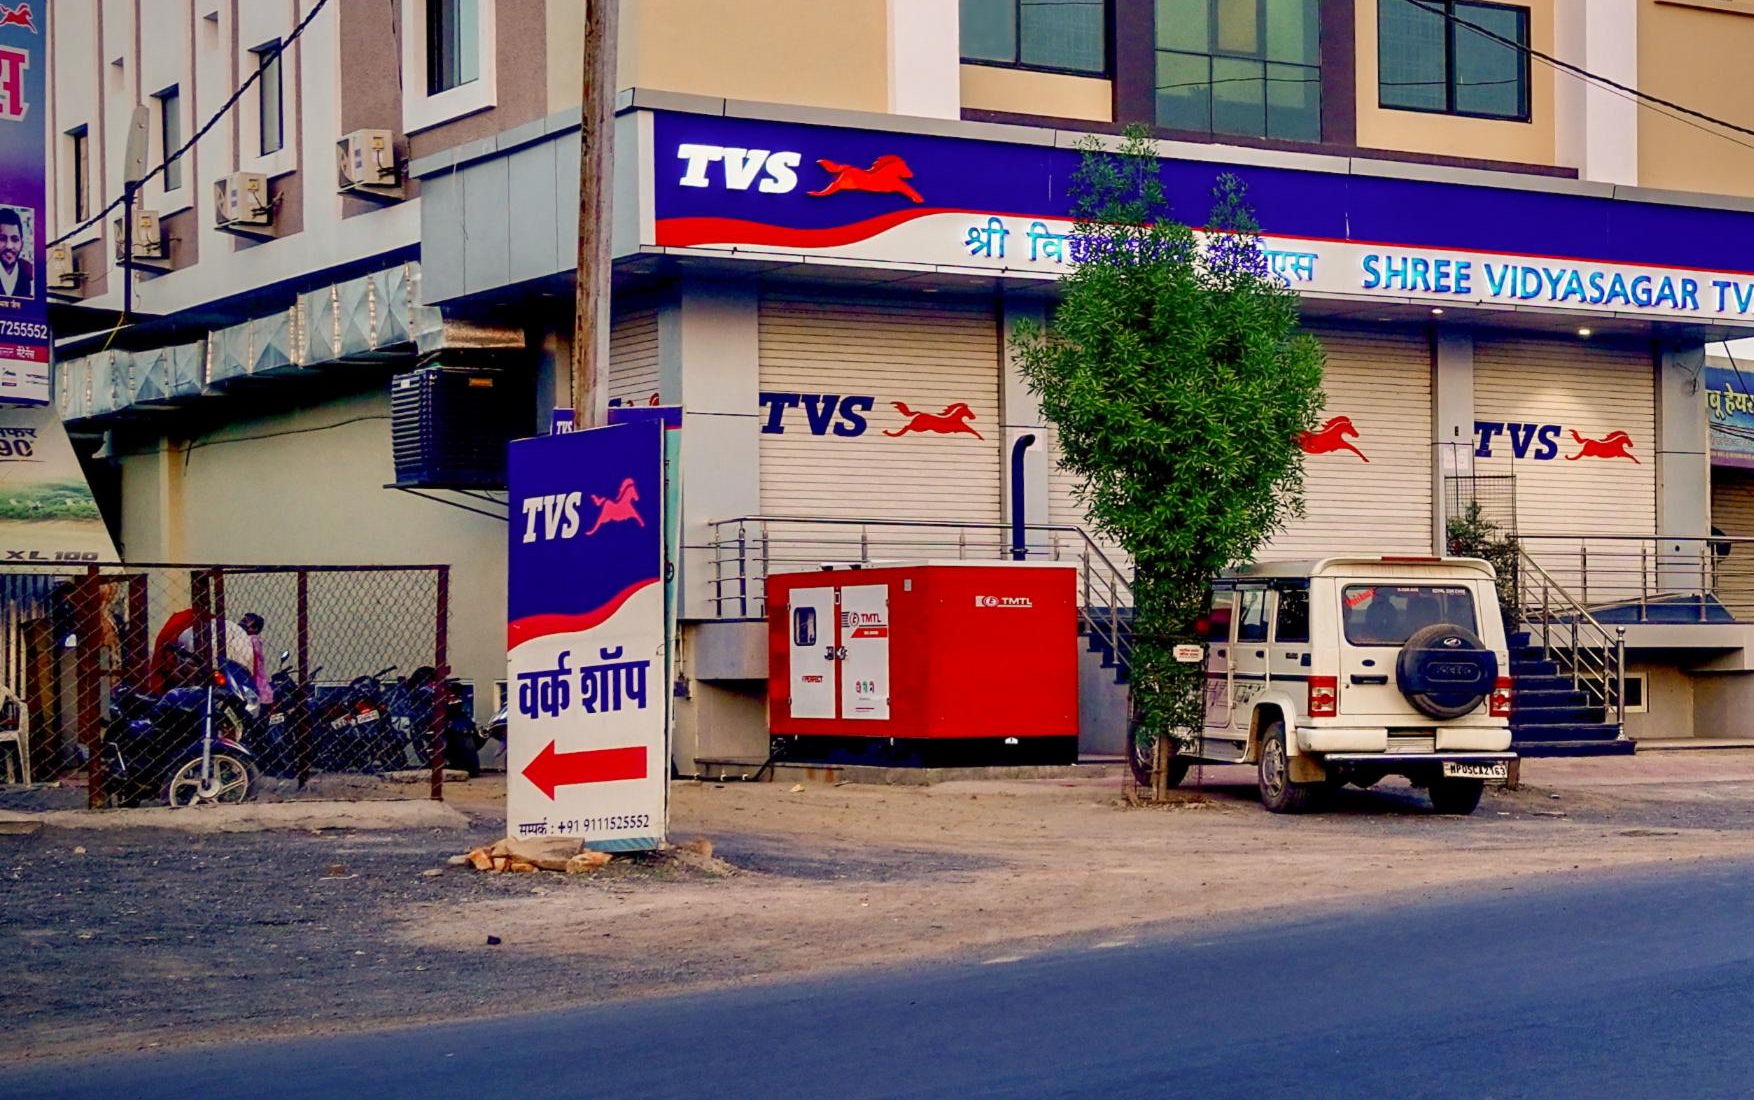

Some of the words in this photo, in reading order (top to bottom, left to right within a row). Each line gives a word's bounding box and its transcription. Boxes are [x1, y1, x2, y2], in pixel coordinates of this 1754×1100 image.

[677, 143, 801, 195] TVS
[964, 216, 1011, 259] श्री
[1363, 253, 1473, 295] SHREE
[1484, 263, 1700, 310] VIDYASAGAR
[556, 420, 574, 435] TVS
[758, 391, 875, 438] TVS
[1475, 420, 1562, 460] TVS
[522, 491, 582, 544] TVS
[4, 550, 49, 560] XL
[55, 551, 98, 561] 100
[861, 612, 882, 624] TMTL
[1001, 597, 1033, 605] TMTL
[517, 651, 572, 720] वर्क
[579, 646, 650, 714] शॉप
[558, 819, 579, 834] +91
[583, 814, 650, 832] 9111525552
